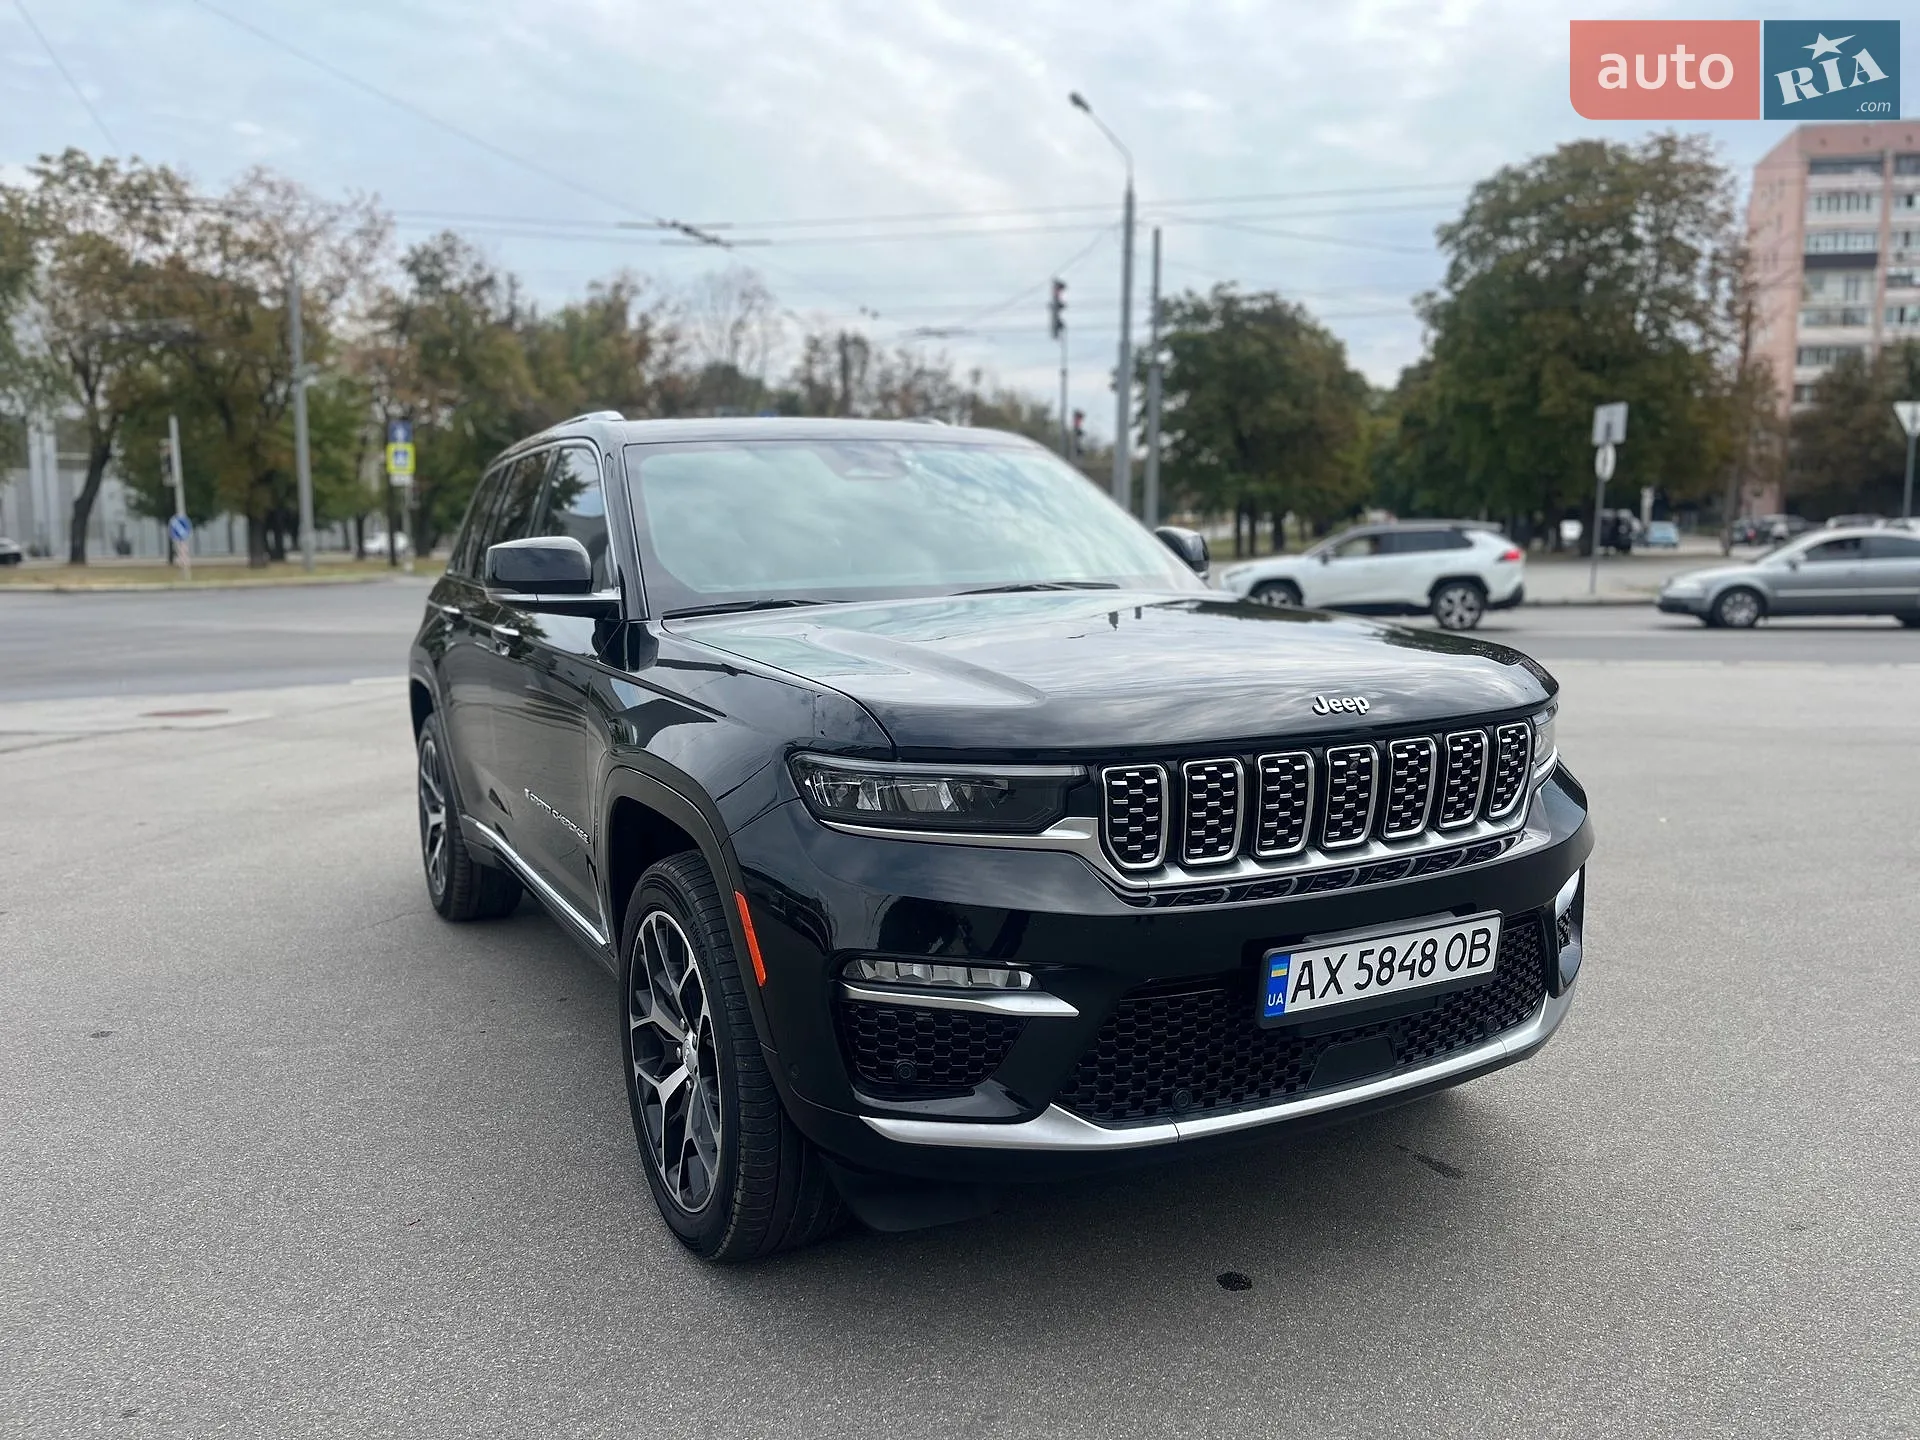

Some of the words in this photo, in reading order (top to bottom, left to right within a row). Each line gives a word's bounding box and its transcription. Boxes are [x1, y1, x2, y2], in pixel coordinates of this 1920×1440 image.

[1312, 695, 1370, 715] Jeep
[1290, 953, 1348, 1003] AX
[1353, 937, 1439, 991] 5848
[1444, 927, 1492, 973] OB
[1267, 991, 1284, 1007] UA
